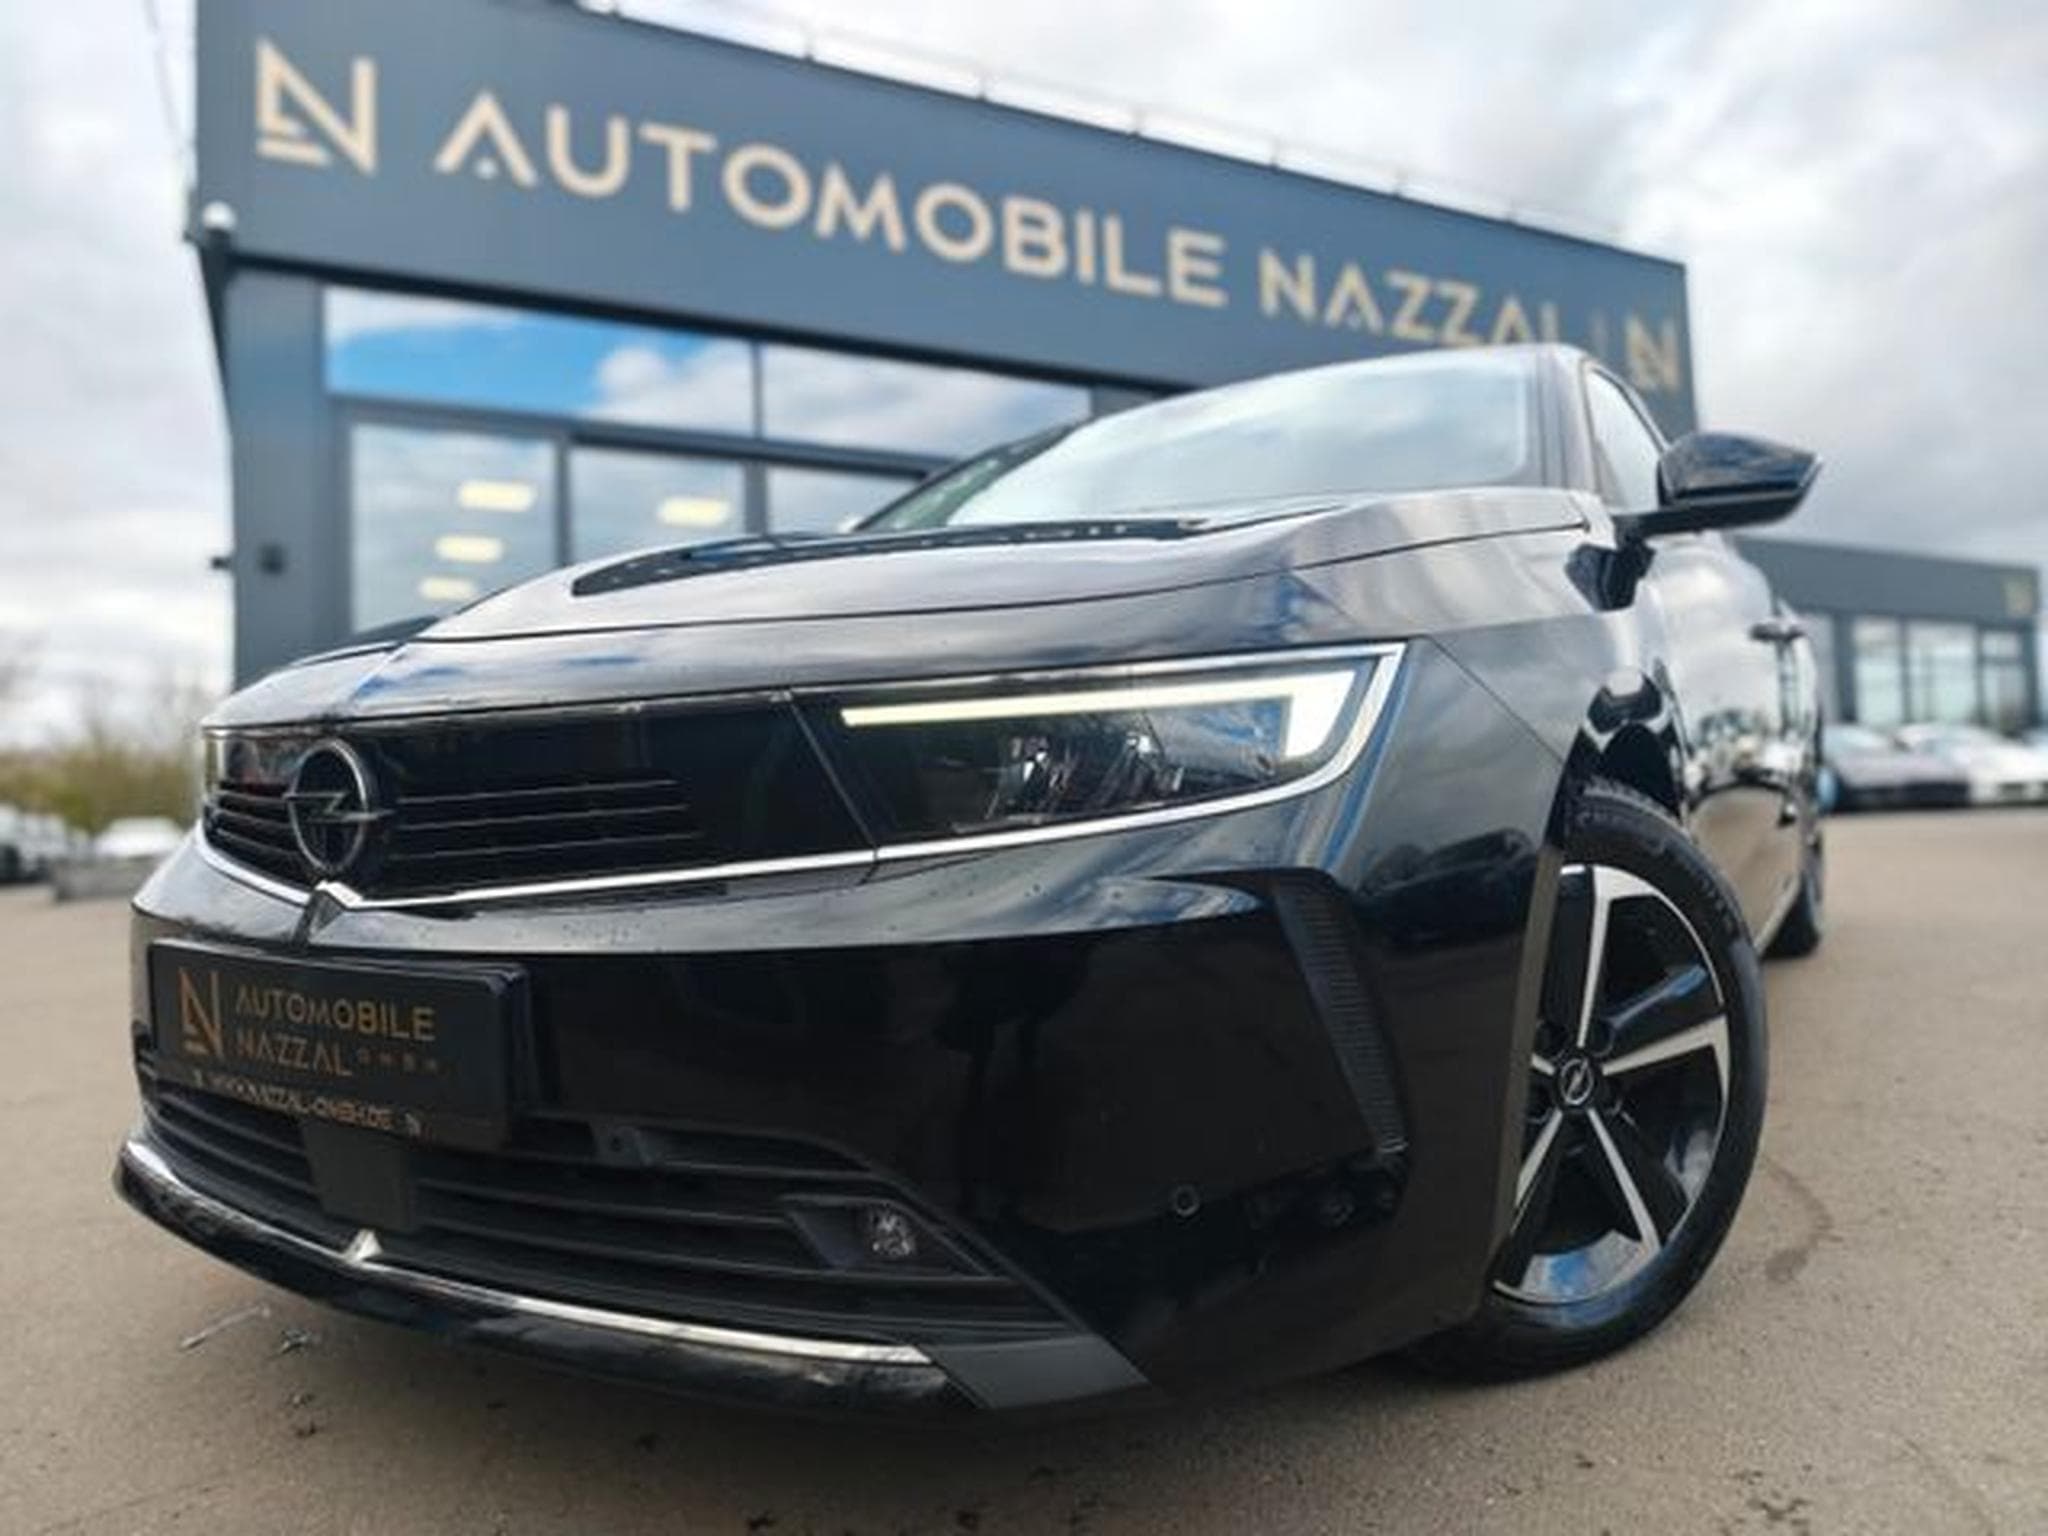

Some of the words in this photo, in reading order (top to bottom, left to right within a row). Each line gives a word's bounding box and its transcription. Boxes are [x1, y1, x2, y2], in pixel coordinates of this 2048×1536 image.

[434, 89, 1229, 308] AUTOMOBILE
[234, 983, 437, 1042] AUTOMOBILE
[235, 1031, 353, 1077] NAZZAL
